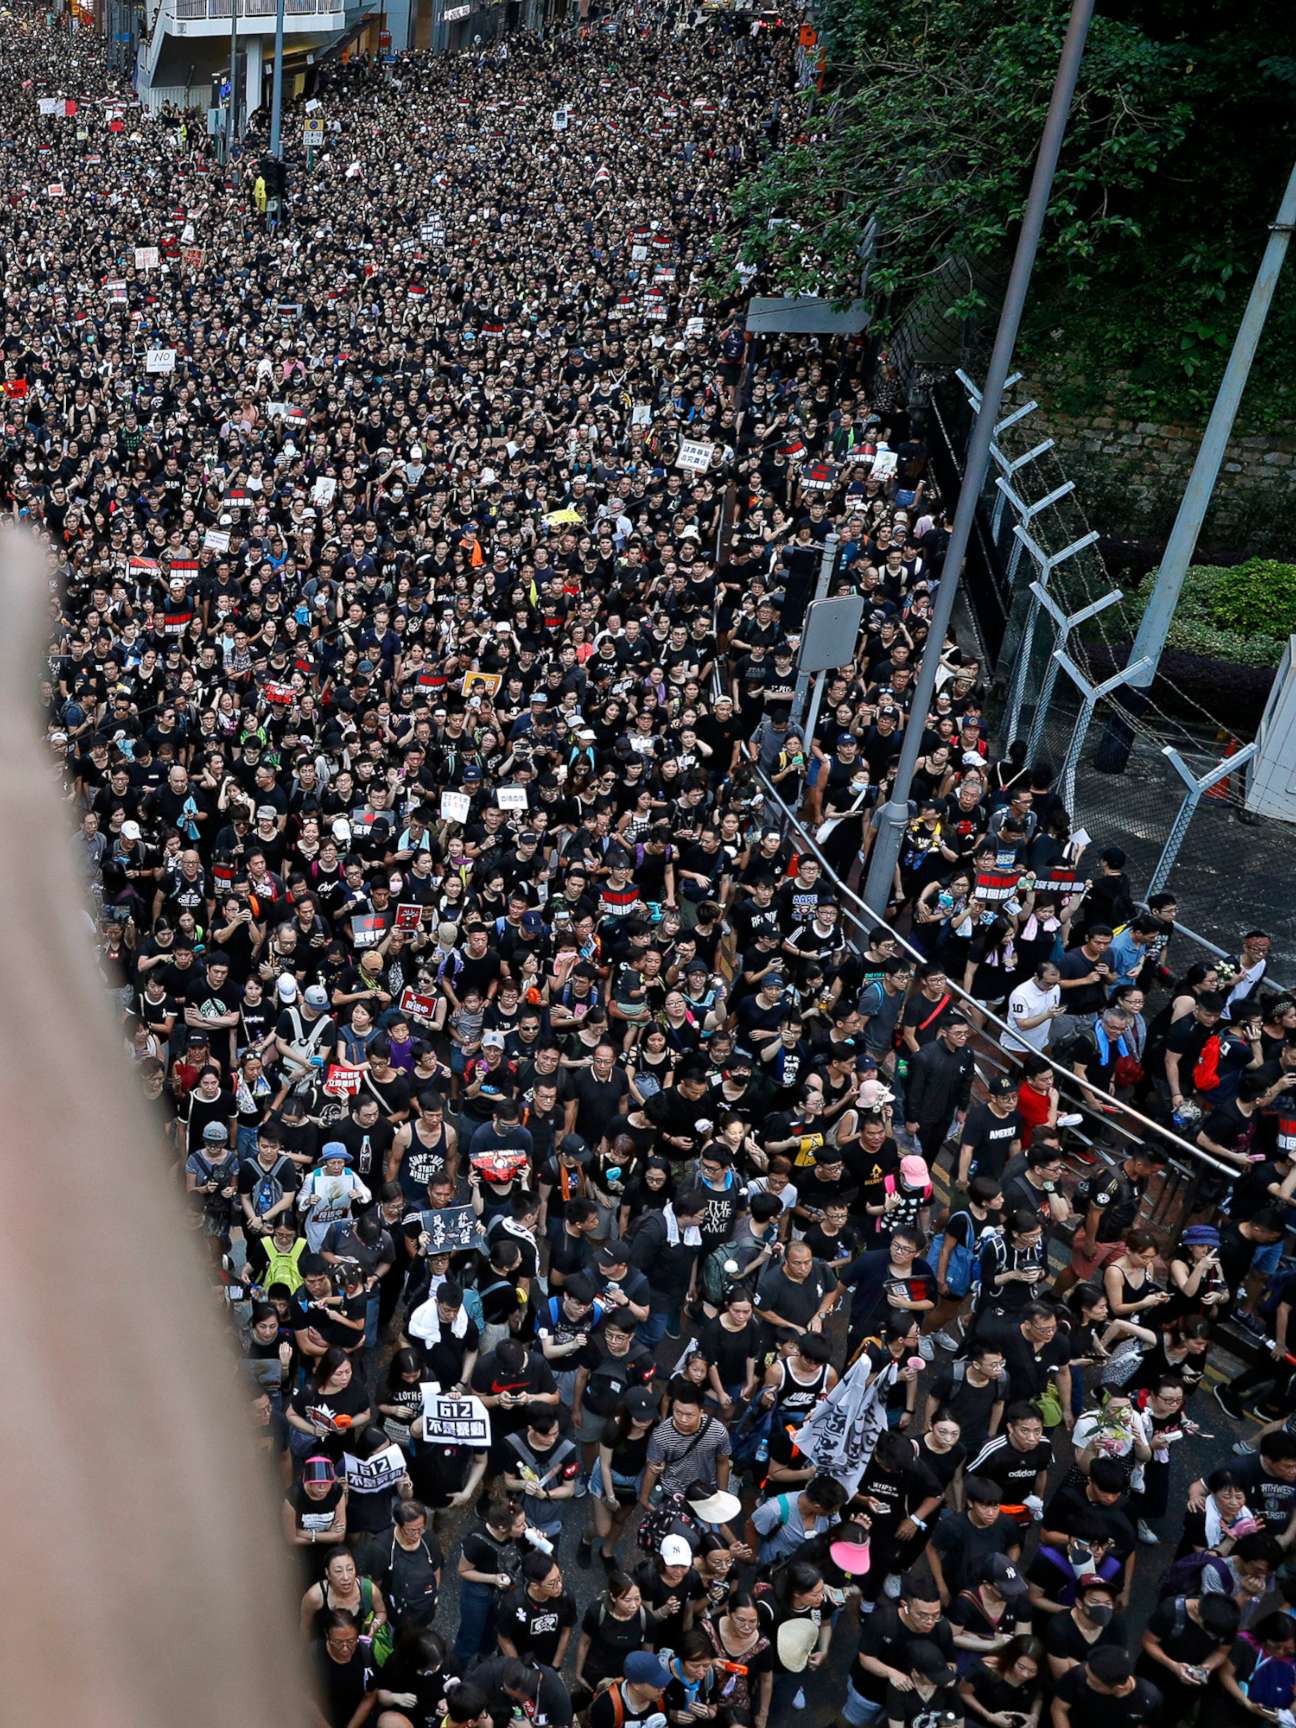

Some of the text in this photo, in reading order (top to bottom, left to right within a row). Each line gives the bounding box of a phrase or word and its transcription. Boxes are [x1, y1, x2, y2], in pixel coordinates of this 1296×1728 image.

[155, 352, 171, 361] NO
[791, 894, 818, 905] AAPE
[1012, 1003, 1023, 1013] 10
[707, 1200, 730, 1210] THE
[439, 1402, 472, 1417] 612
[428, 1418, 485, 1439] 不是暴動
[360, 1459, 390, 1475] 612
[1008, 1469, 1037, 1478] adidas
[1005, 1566, 1016, 1579] NY
